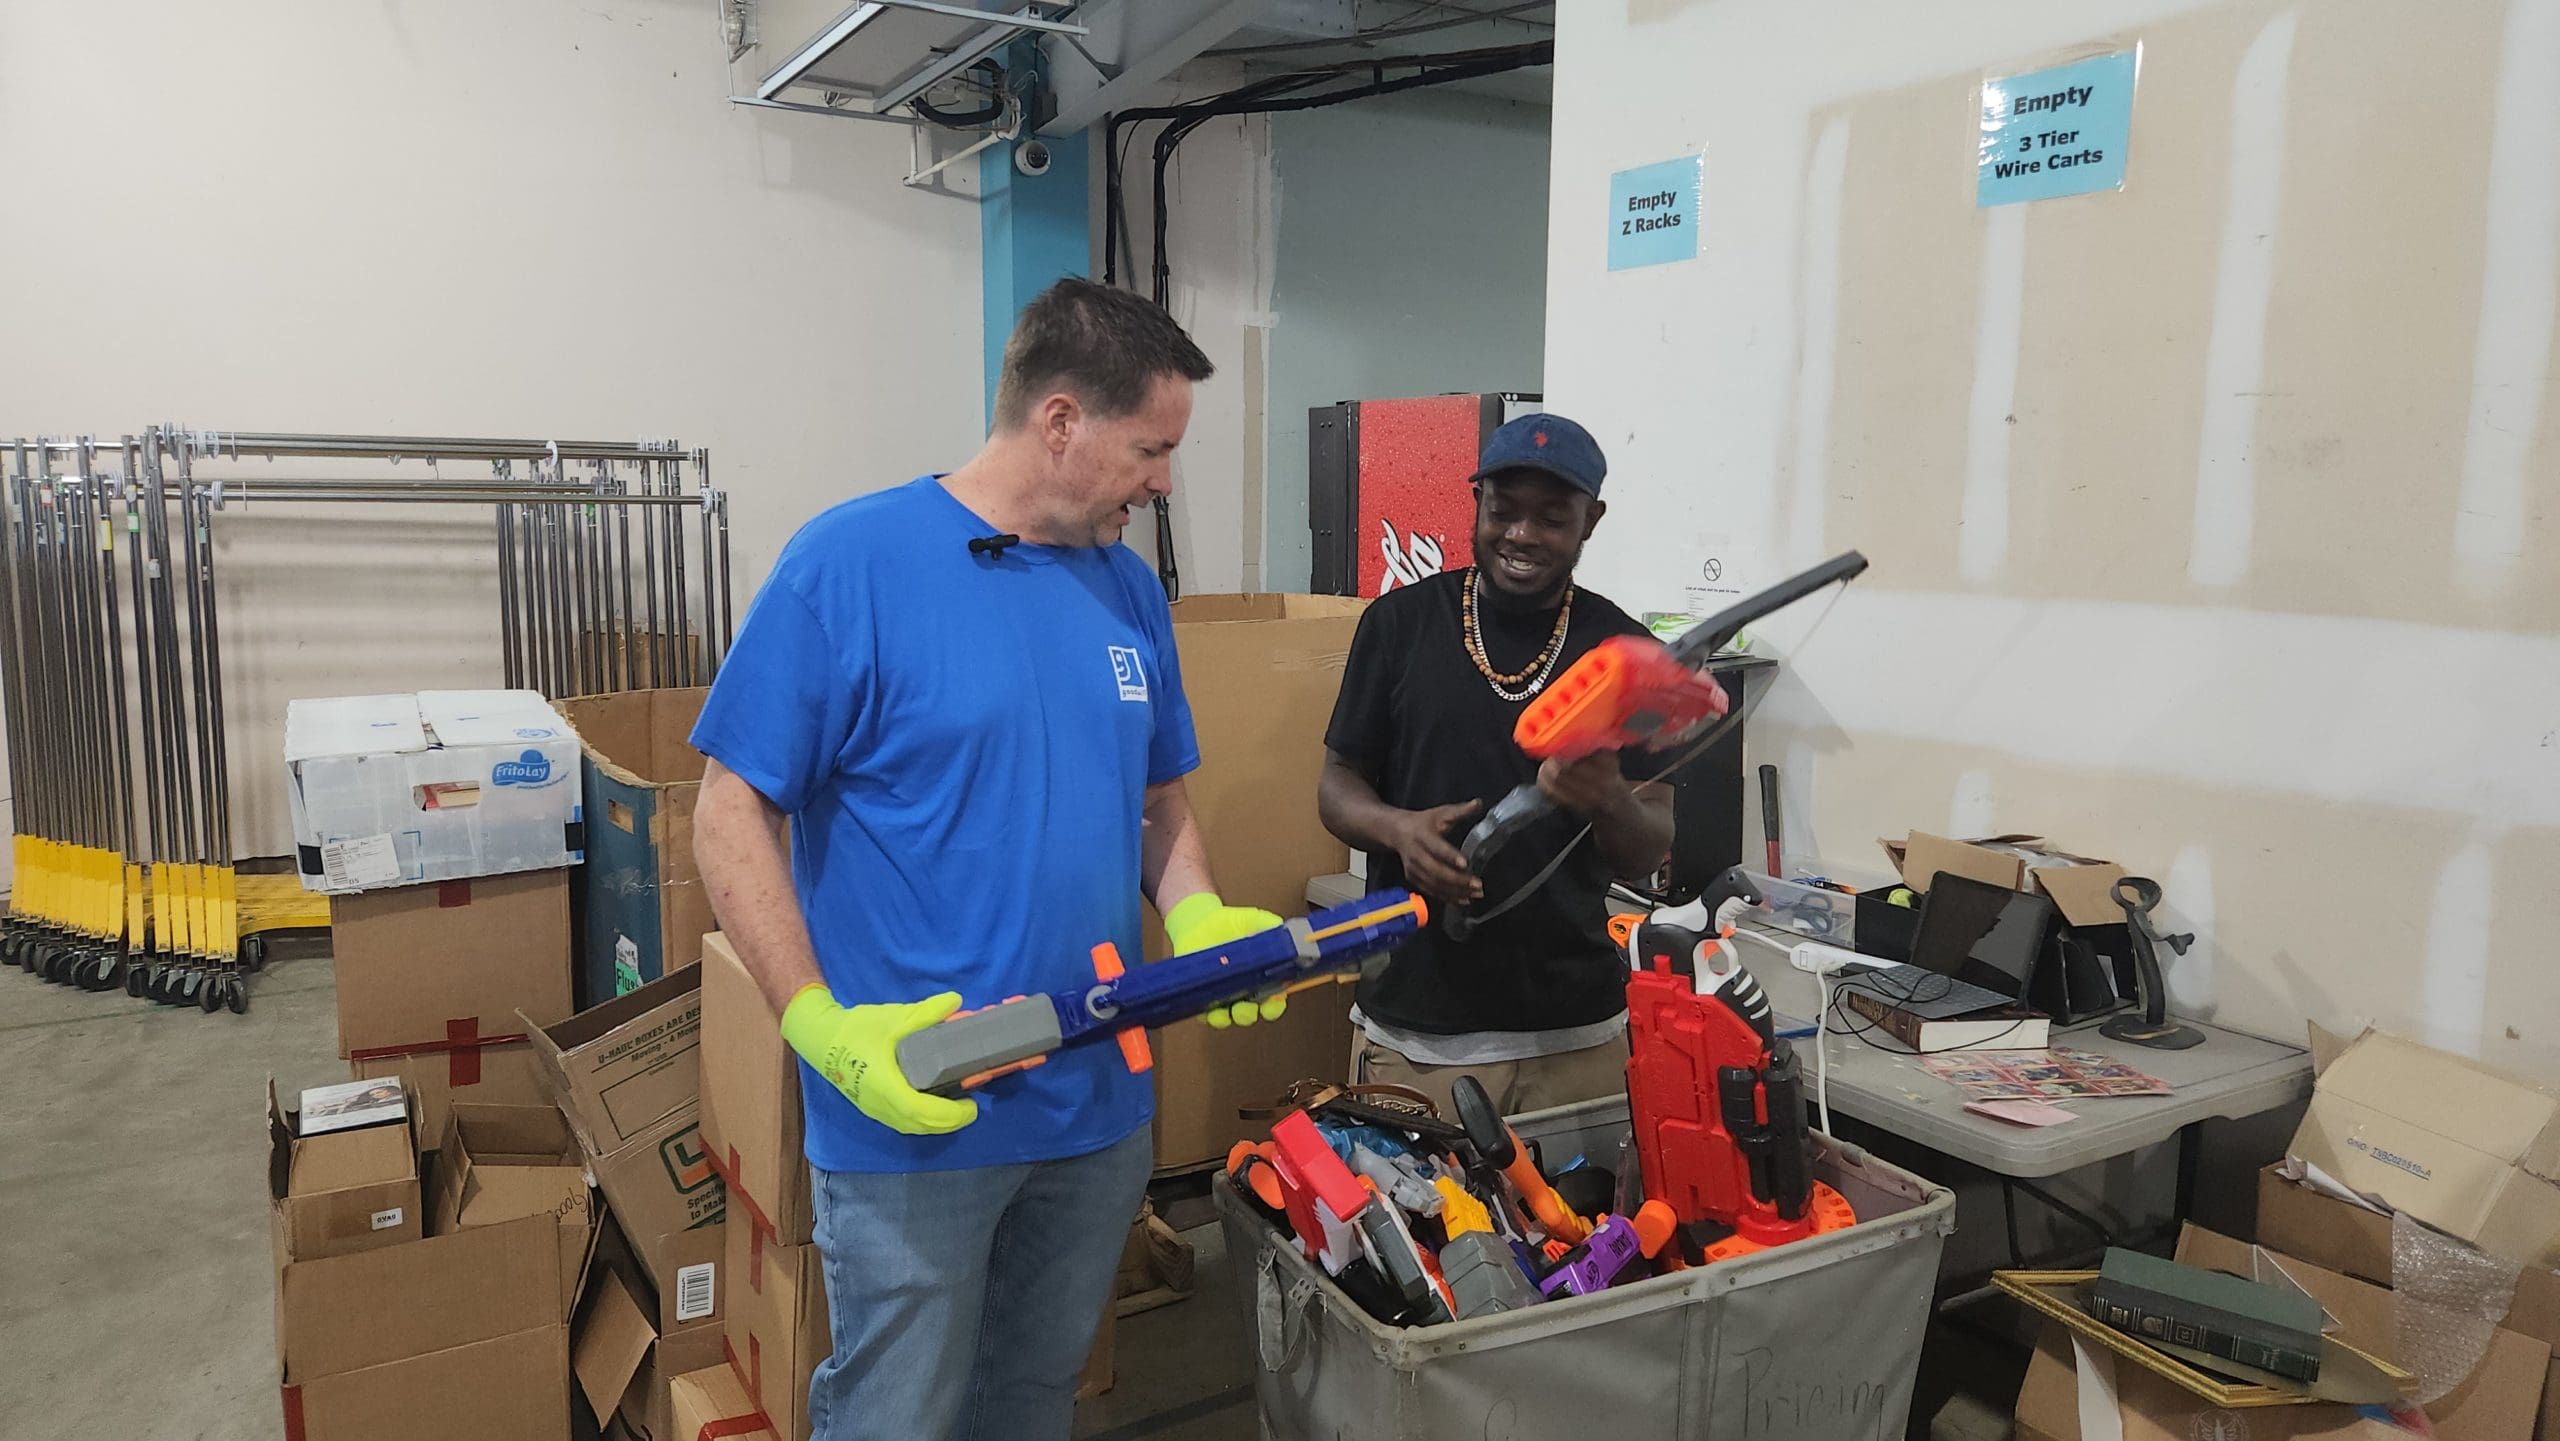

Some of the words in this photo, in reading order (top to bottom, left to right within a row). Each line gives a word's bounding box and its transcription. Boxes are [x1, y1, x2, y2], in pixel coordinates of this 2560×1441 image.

[2013, 85, 2094, 116] Empty
[2018, 135, 2032, 153] 3
[2037, 130, 2080, 149] Tier
[1994, 159, 2041, 180] Wire
[2047, 149, 2103, 170] Carts
[1628, 190, 1677, 212] Empty
[1622, 220, 1632, 236] Z
[1635, 212, 1681, 233] Racks
[635, 1025, 665, 1046] BOXES
[666, 1015, 684, 1031] ARE
[631, 1043, 662, 1063] Moving
